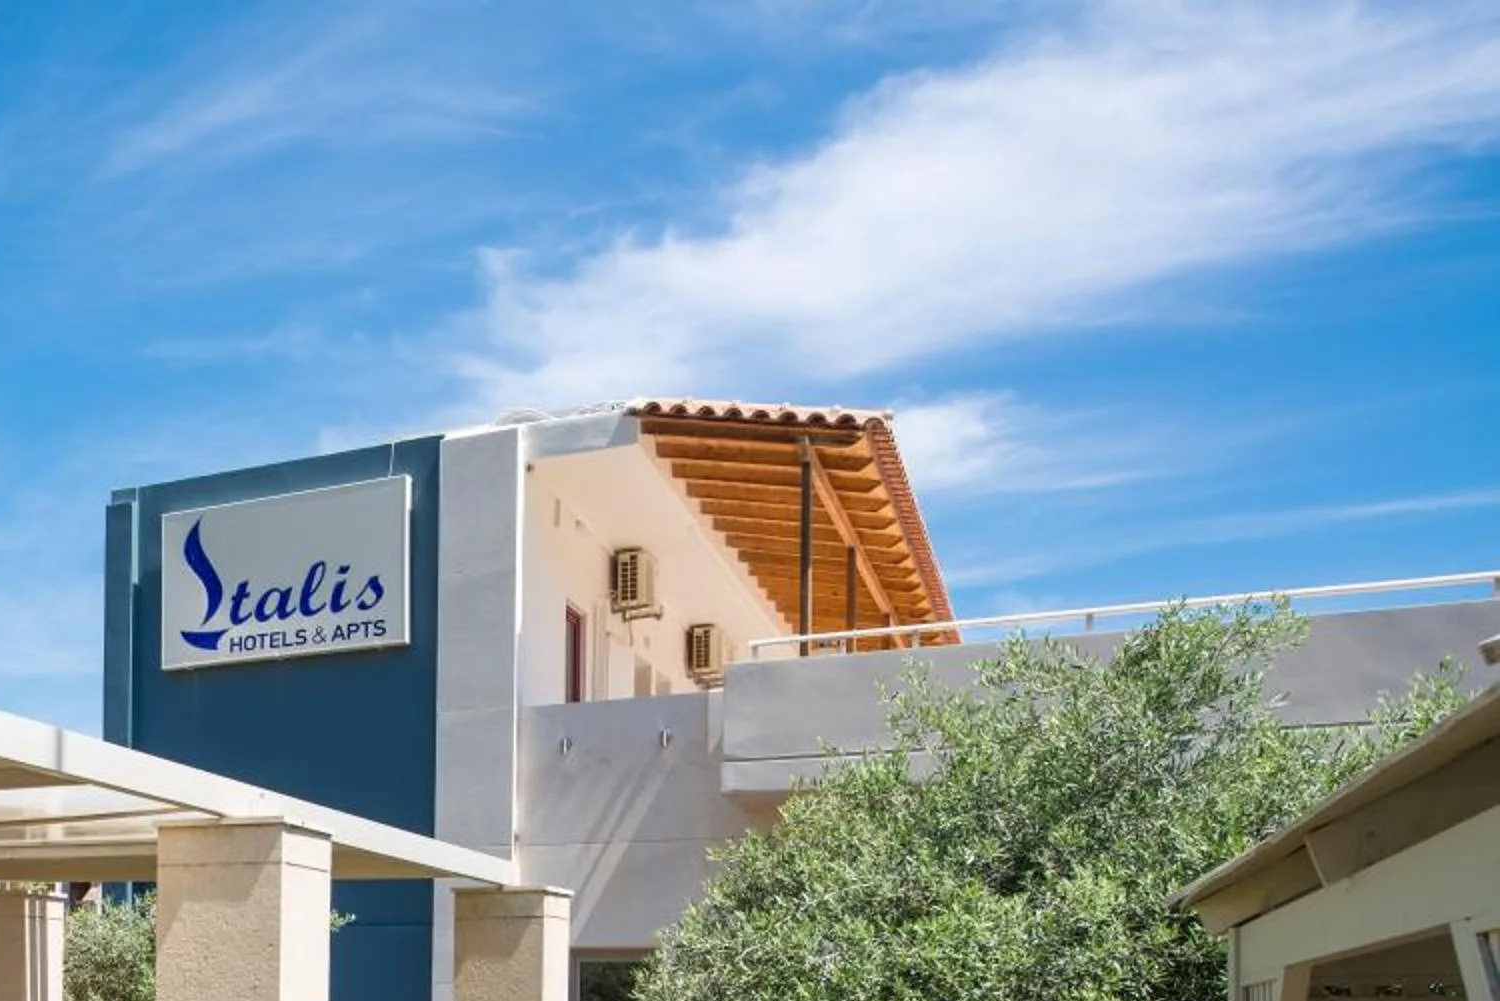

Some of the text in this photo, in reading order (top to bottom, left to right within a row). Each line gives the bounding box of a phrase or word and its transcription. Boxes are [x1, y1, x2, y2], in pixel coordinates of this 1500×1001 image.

[181, 516, 384, 650] Stalis
[230, 620, 386, 652] HOTELS & APTS
